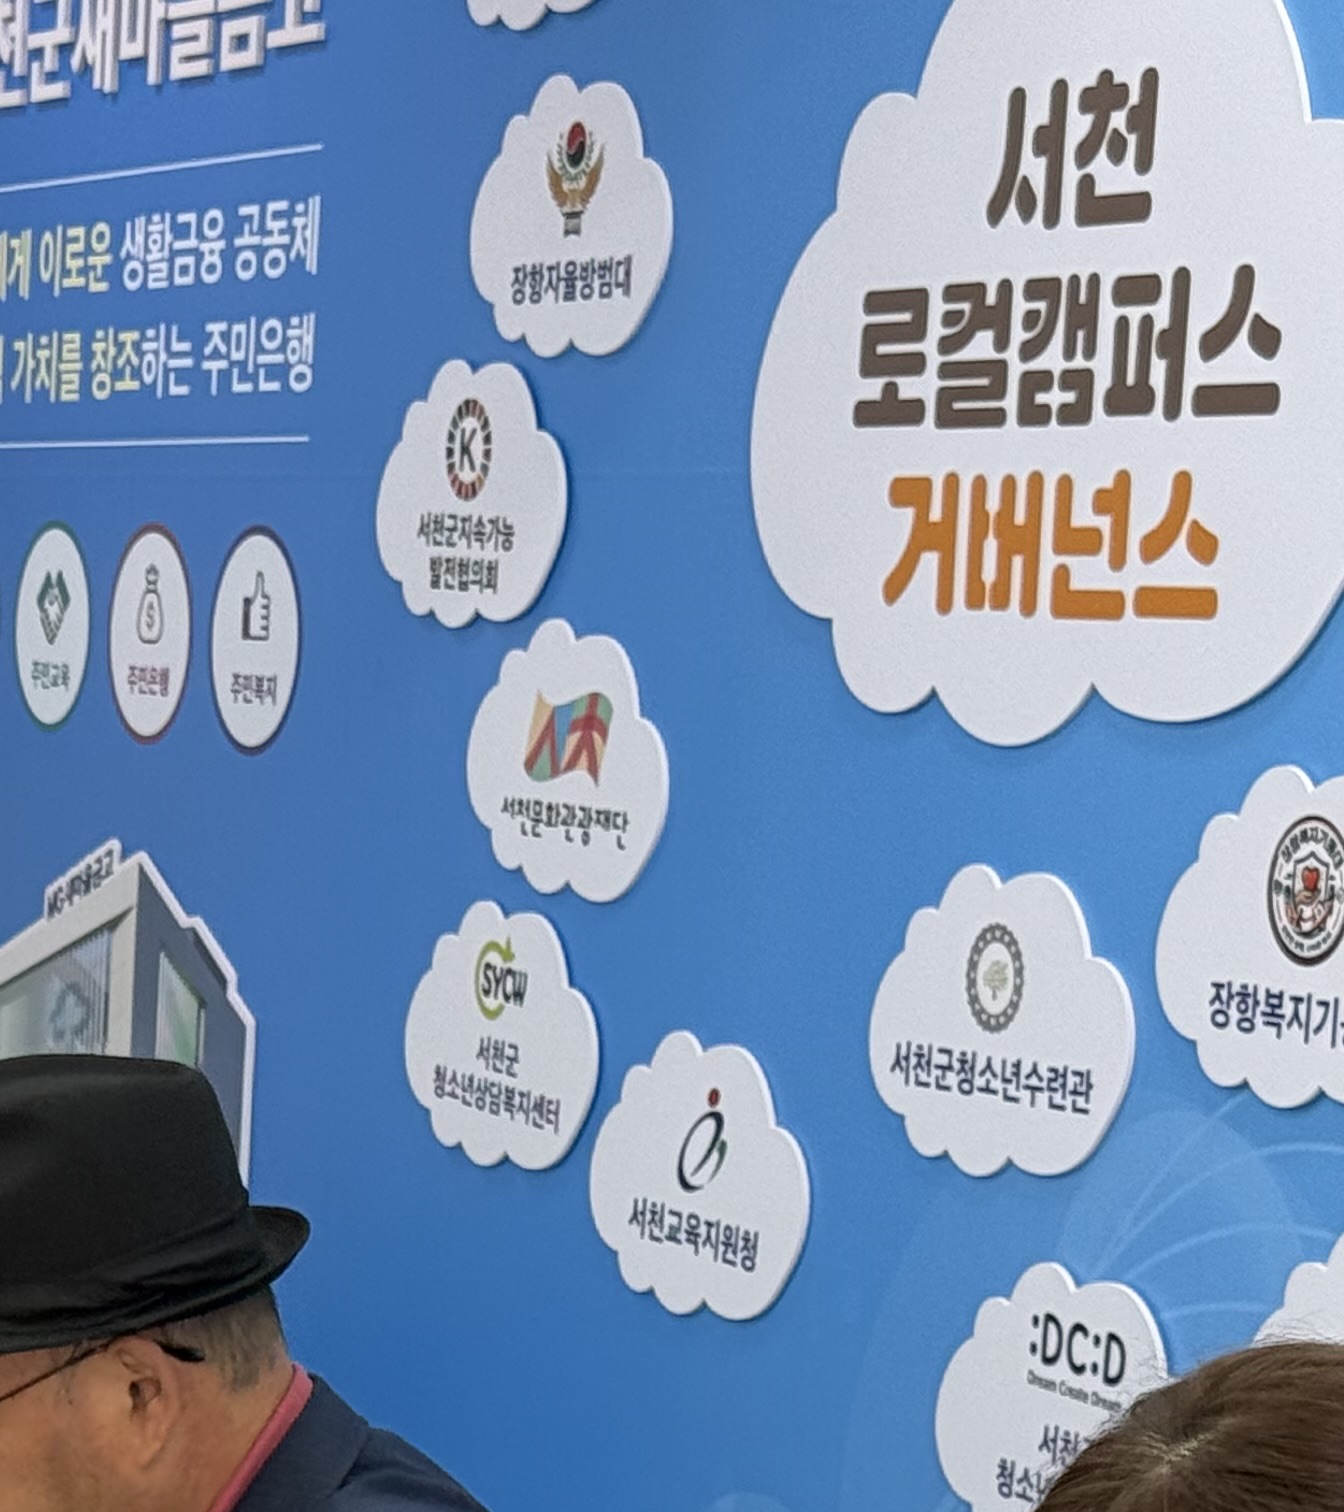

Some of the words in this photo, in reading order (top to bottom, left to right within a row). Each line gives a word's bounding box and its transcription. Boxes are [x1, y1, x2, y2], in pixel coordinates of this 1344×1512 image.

[986, 66, 1159, 230] 서천
[38, 222, 113, 298] 이로운
[120, 208, 226, 291] 생활금융
[233, 195, 321, 275] 공동체
[511, 254, 632, 306] 장항자율방범대
[11, 331, 83, 404] 가치를
[91, 323, 194, 400] 창조하는
[201, 312, 316, 396] 주민은행
[853, 264, 1282, 430] 로컬캠퍼스
[459, 427, 477, 473] K
[417, 512, 515, 552] 서천군지속가능
[881, 469, 1219, 621] 거버넌스
[429, 556, 499, 594] 발전협의회
[501, 797, 629, 851] 서천문화관광재단
[482, 961, 528, 1008] SYCW
[1209, 981, 1344, 1050] 장항복지기
[476, 1036, 520, 1079] 서천군
[890, 1040, 1093, 1115] 서천군청소년수련관
[433, 1064, 561, 1135] 청소년상담복지센터
[628, 1197, 759, 1273] 서천교육지원청
